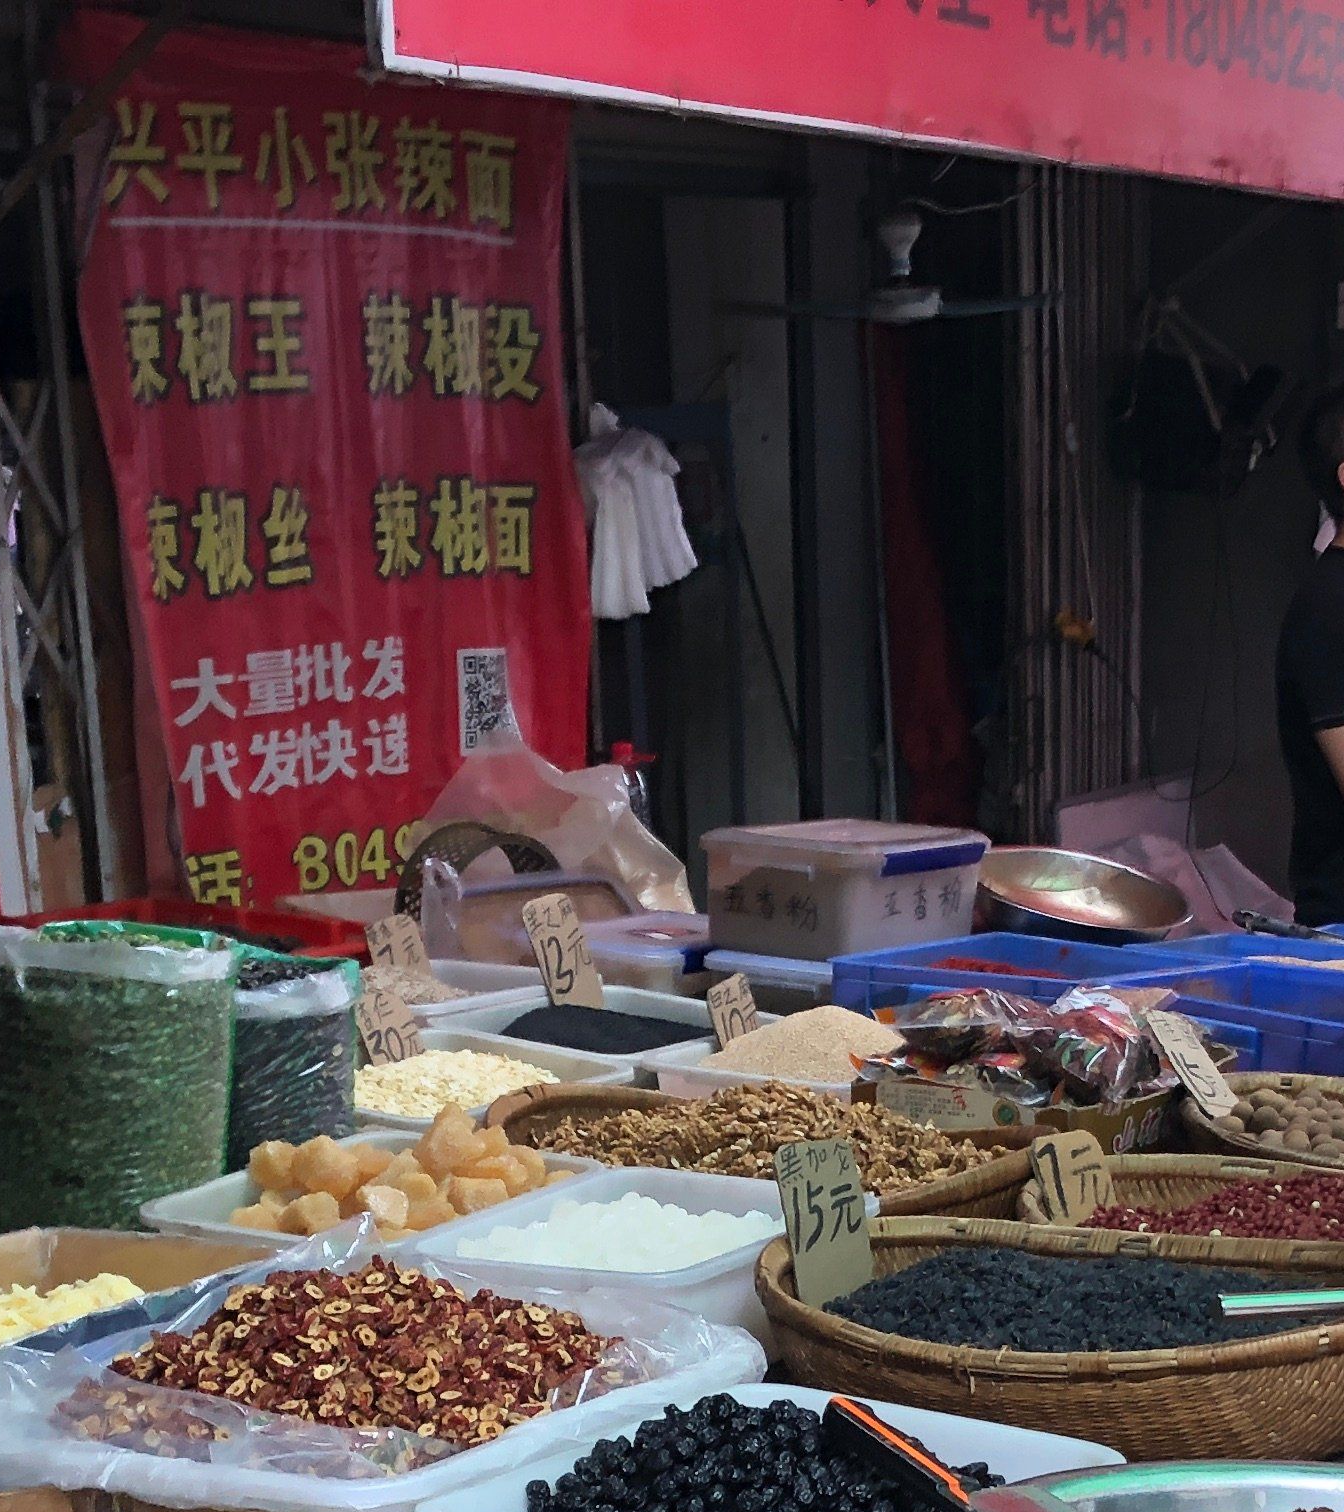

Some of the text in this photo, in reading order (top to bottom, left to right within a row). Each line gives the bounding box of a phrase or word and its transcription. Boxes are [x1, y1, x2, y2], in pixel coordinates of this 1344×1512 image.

[104, 97, 516, 229] 兴平小张辣面
[374, 480, 535, 577] 辣椒面
[172, 635, 405, 727] 大量批发
[179, 714, 409, 807] 代发快递
[792, 1181, 862, 1253] 15元
